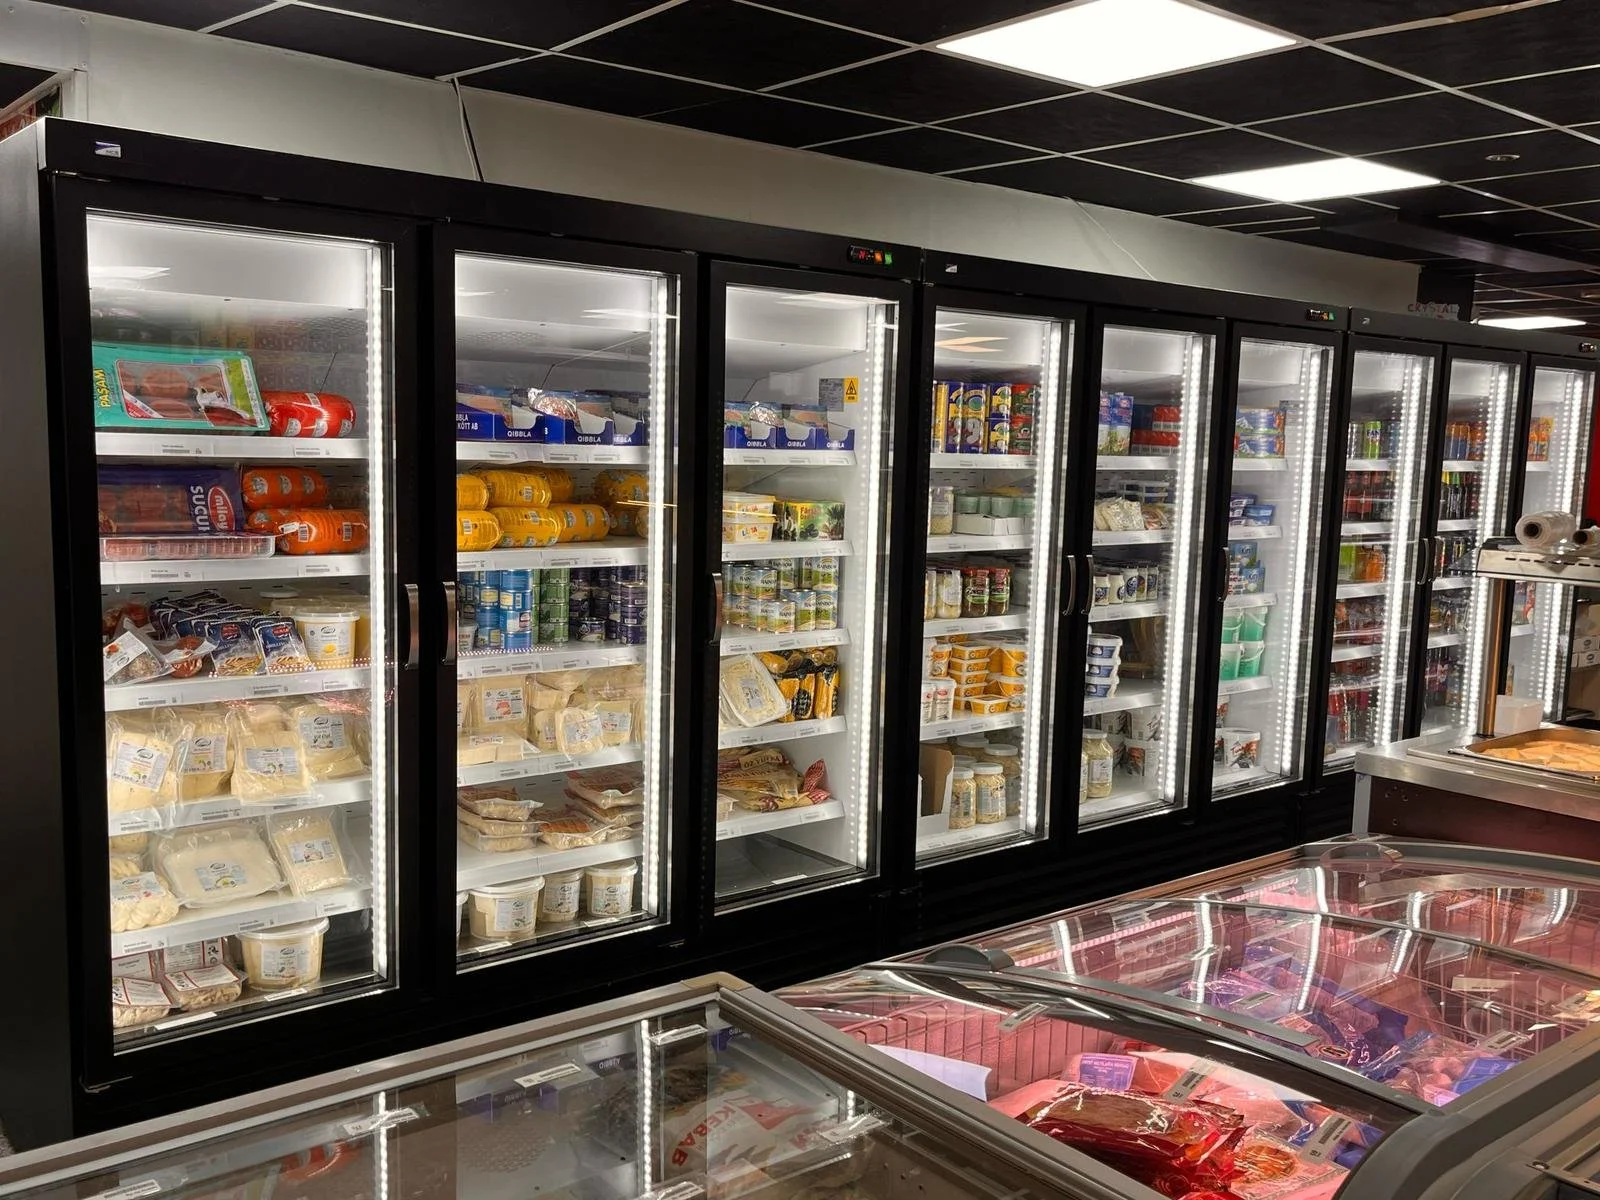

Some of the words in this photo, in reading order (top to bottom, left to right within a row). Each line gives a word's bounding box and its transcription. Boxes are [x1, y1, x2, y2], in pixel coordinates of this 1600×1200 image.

[507, 430, 532, 438] QIBBLA
[577, 435, 601, 443] QIBBLA
[671, 1106, 736, 1167] KEBAB
